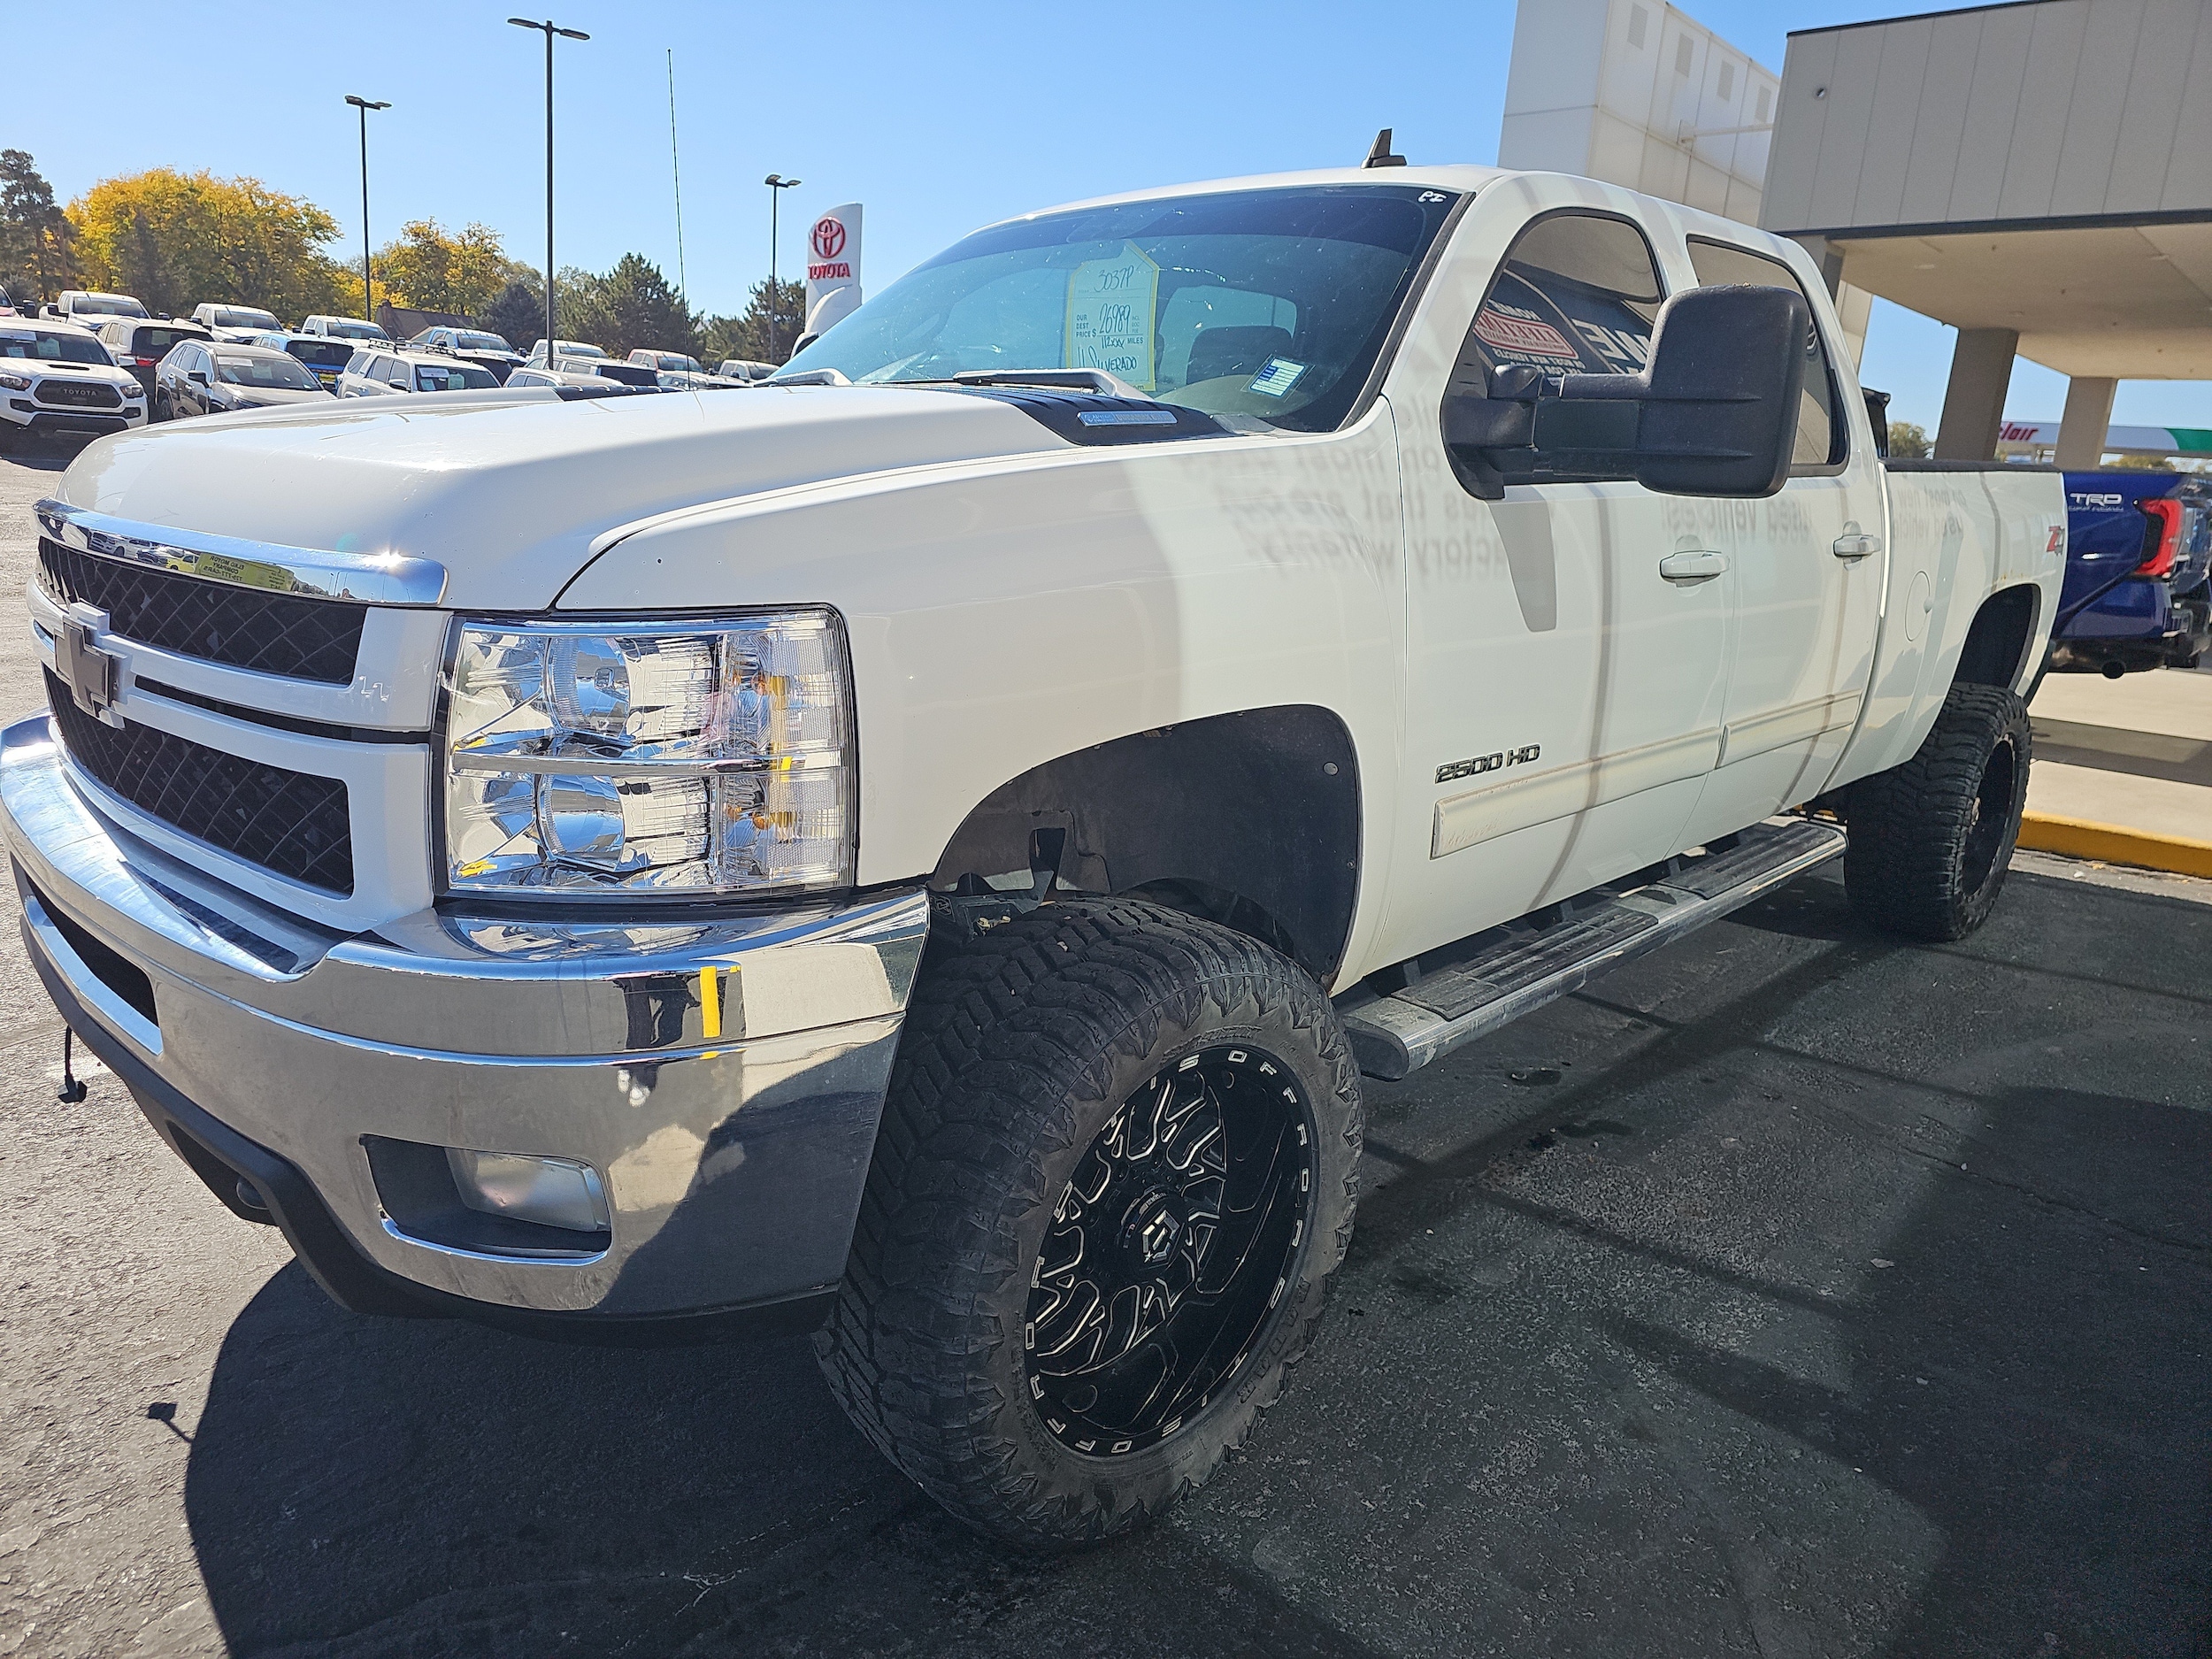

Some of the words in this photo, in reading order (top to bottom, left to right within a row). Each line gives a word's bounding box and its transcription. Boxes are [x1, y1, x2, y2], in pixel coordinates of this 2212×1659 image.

[808, 263, 851, 280] TOYOTA
[1099, 303, 1131, 334] 26989
[1091, 327, 1097, 338] $
[2070, 493, 2123, 507] TRD
[1434, 752, 1503, 784] 2500
[1506, 744, 1540, 767] HD
